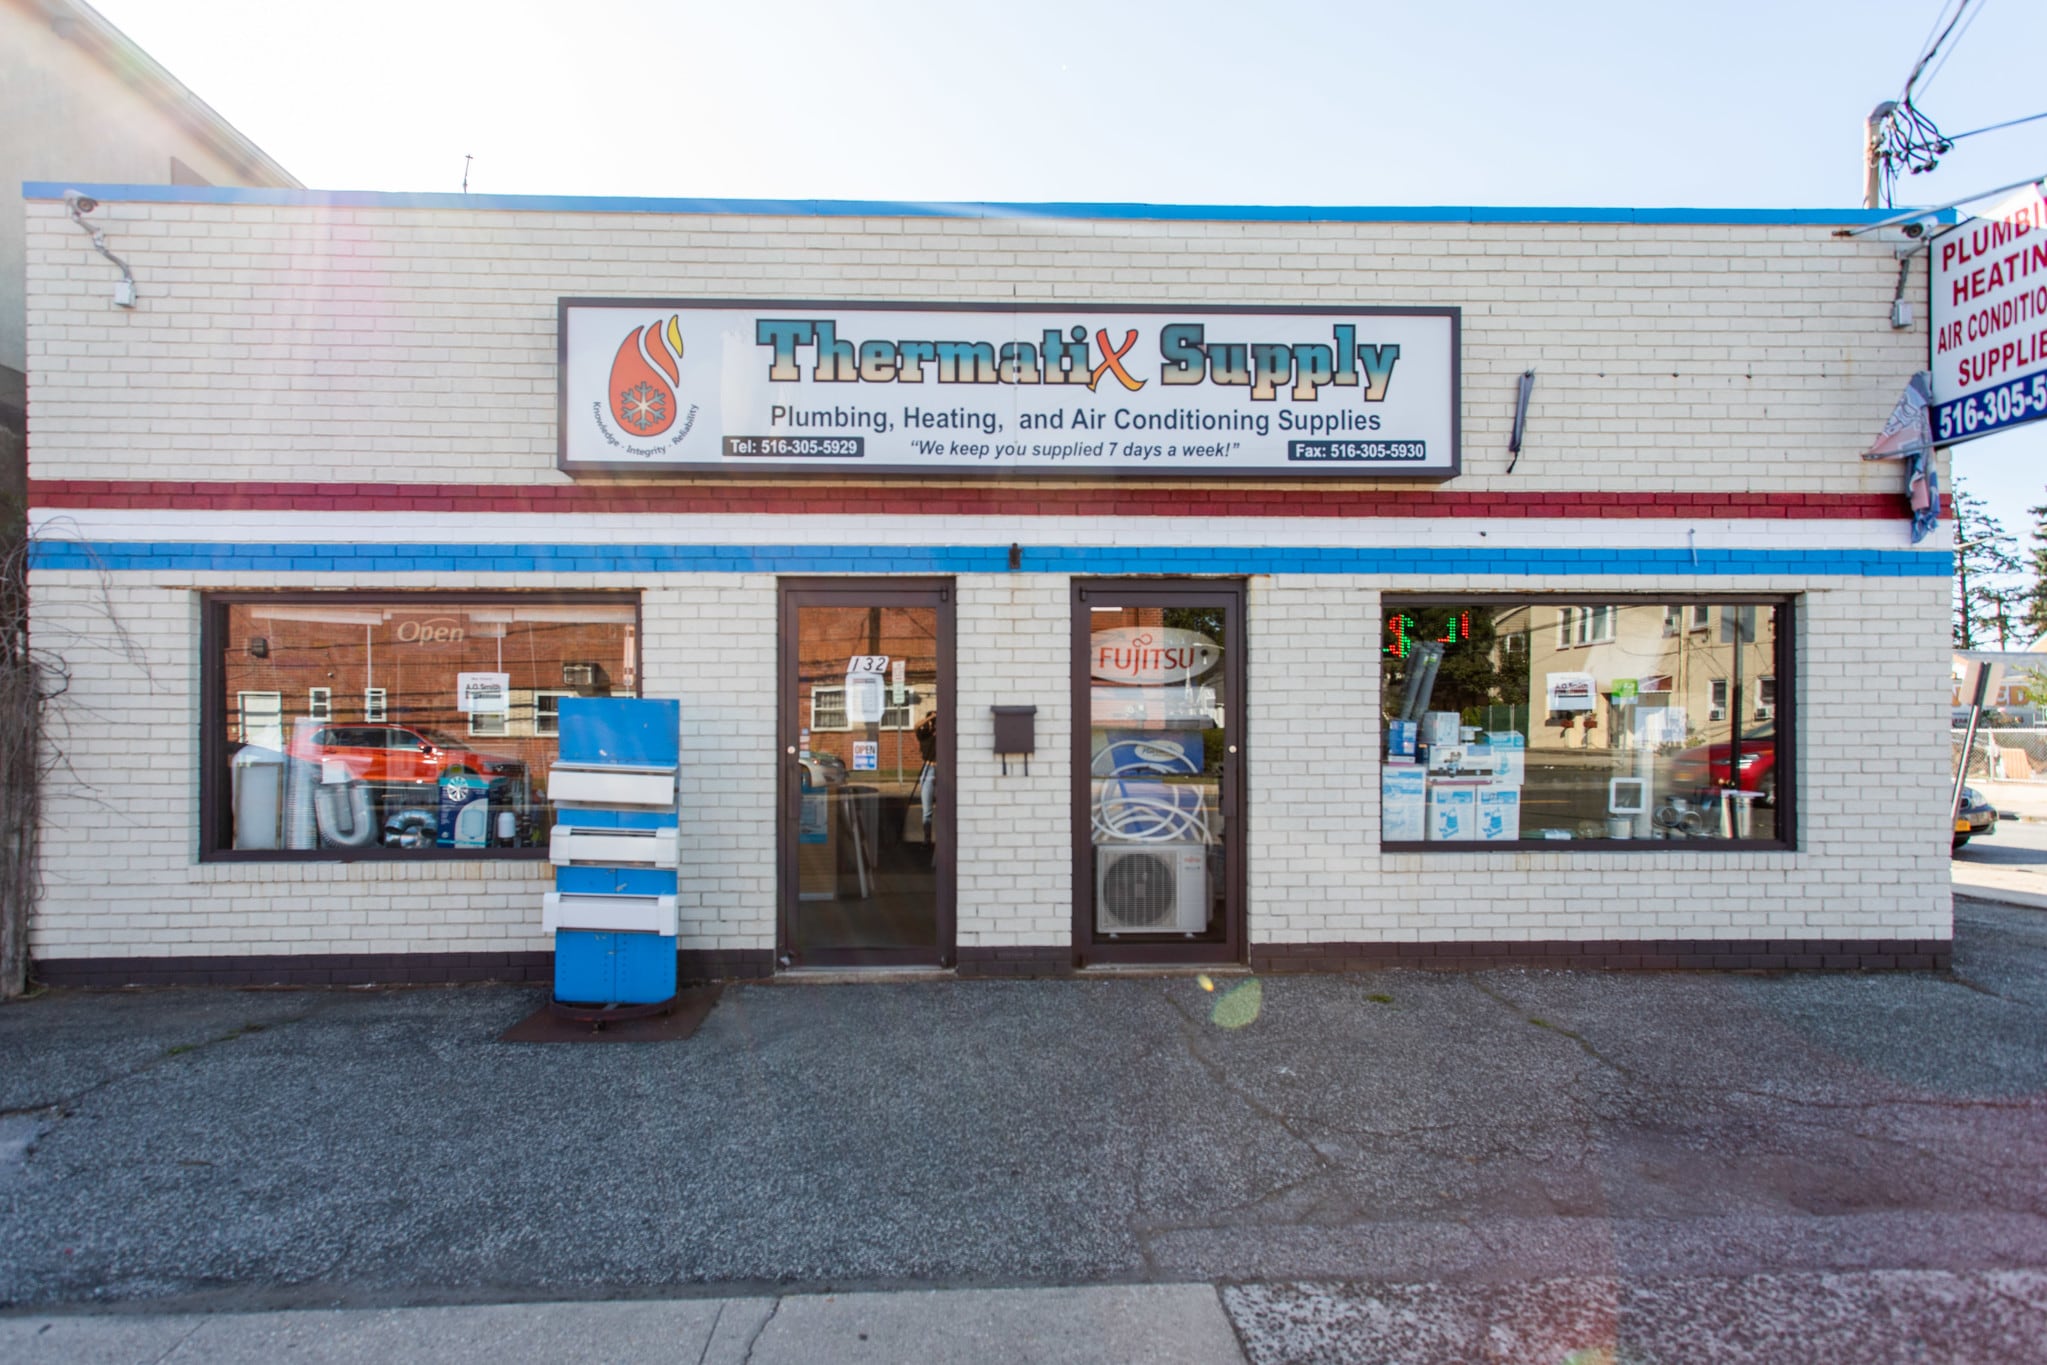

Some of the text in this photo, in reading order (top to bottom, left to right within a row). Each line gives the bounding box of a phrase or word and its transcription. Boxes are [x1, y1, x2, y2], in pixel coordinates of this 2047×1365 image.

[1938, 320, 1962, 354] AIR
[1160, 323, 1400, 402] Supply
[1940, 374, 2047, 438] 516-305-5
[593, 401, 699, 458] Knowledge Integrity Reliability
[771, 405, 1381, 436] Plumbing, Heating, and Air Conditioning Supplies
[730, 439, 857, 454] Tel: 516-305-5929
[950, 440, 989, 459] keep
[994, 444, 1027, 459] you
[1032, 442, 1104, 460] supplied
[1109, 442, 1118, 456] 7
[1123, 442, 1162, 460] days
[1168, 446, 1176, 456] a
[1296, 444, 1424, 458] Fax: 516-305-5930
[397, 620, 464, 646] Open
[852, 657, 886, 671] 132
[1099, 646, 1195, 676] FUJITSU
[855, 744, 875, 754] OPEN
